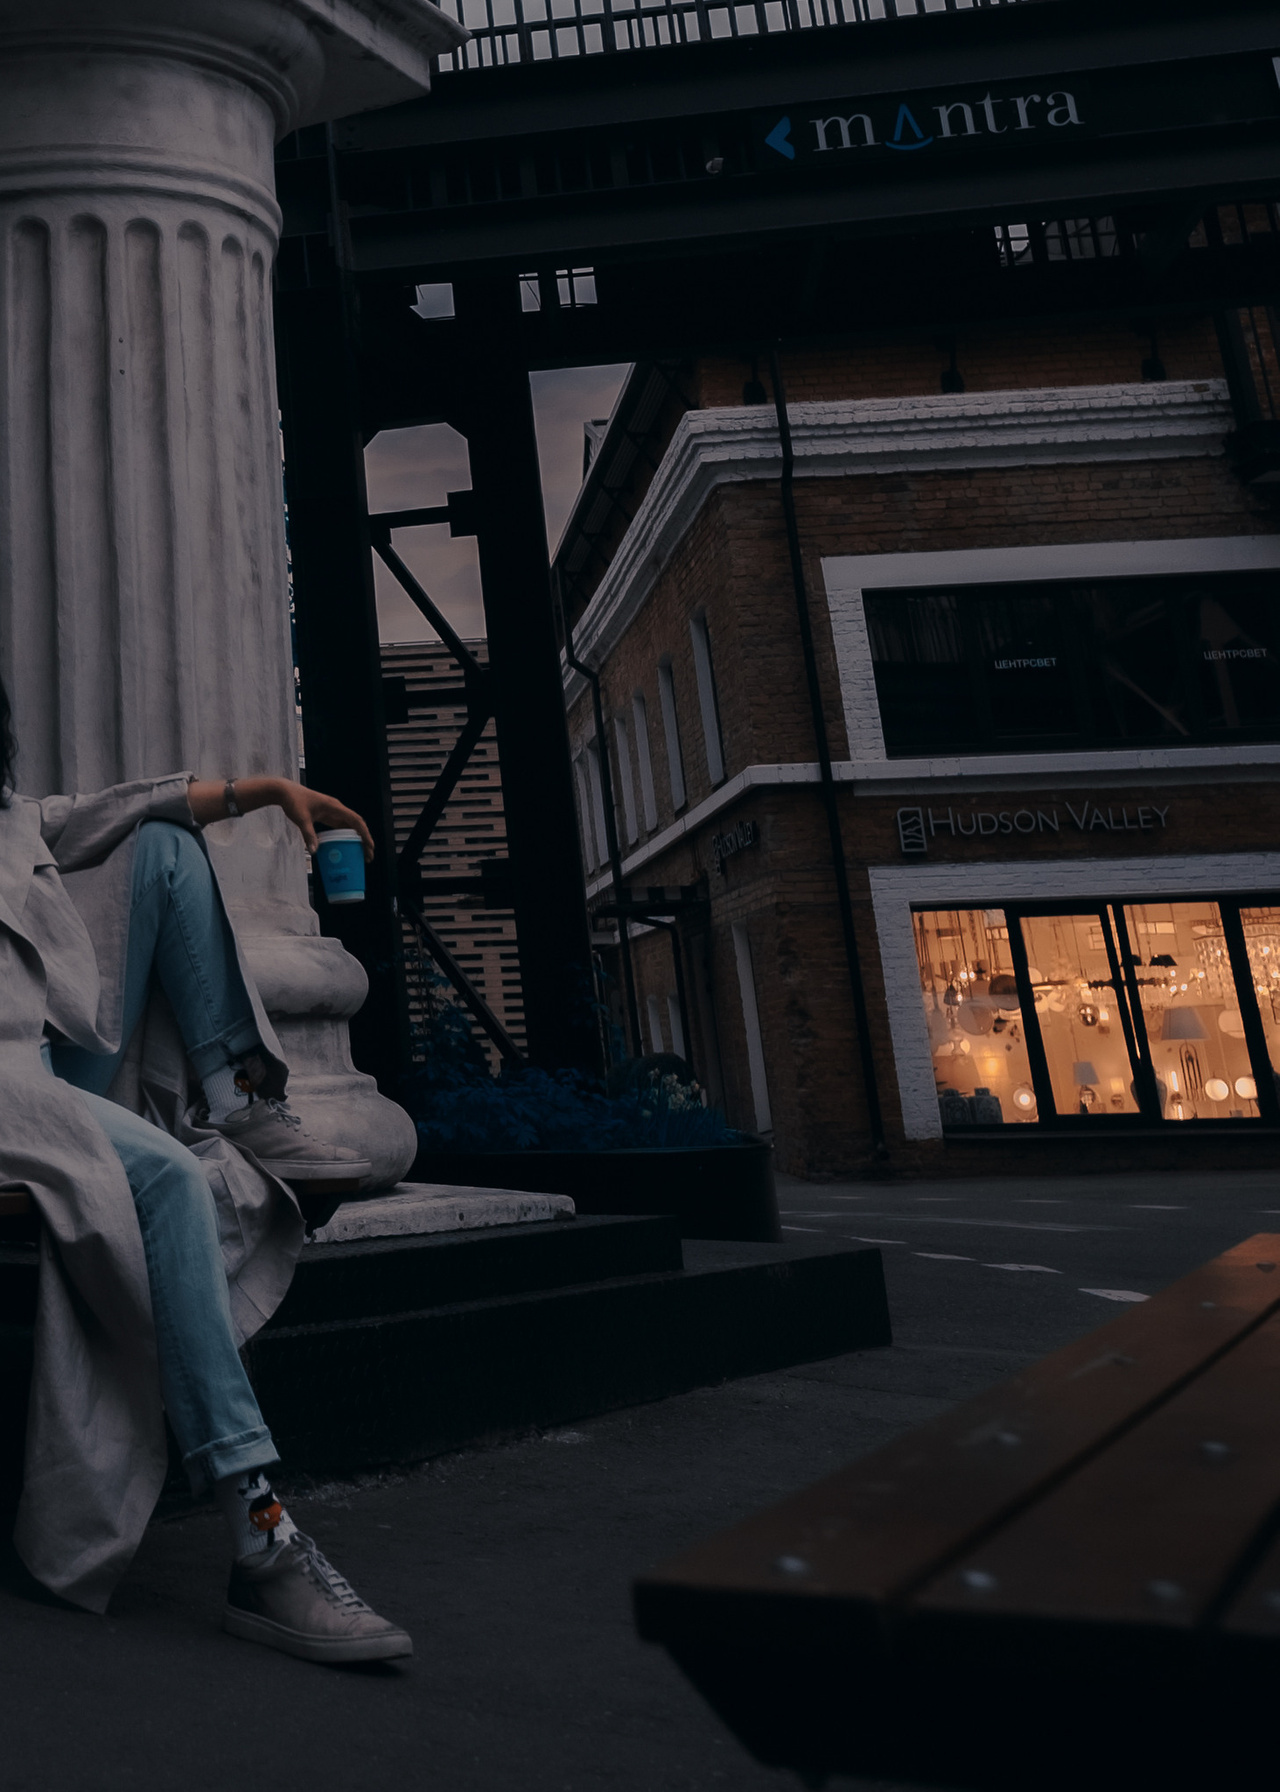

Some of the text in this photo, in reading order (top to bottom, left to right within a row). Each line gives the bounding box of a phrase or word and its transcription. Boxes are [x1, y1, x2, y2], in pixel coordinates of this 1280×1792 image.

[1203, 648, 1268, 661] ЦЕНТРСВЕТ
[994, 656, 1057, 670] ЦЕНТРСВЕТ
[927, 800, 1170, 837] HUDSON VALLEY
